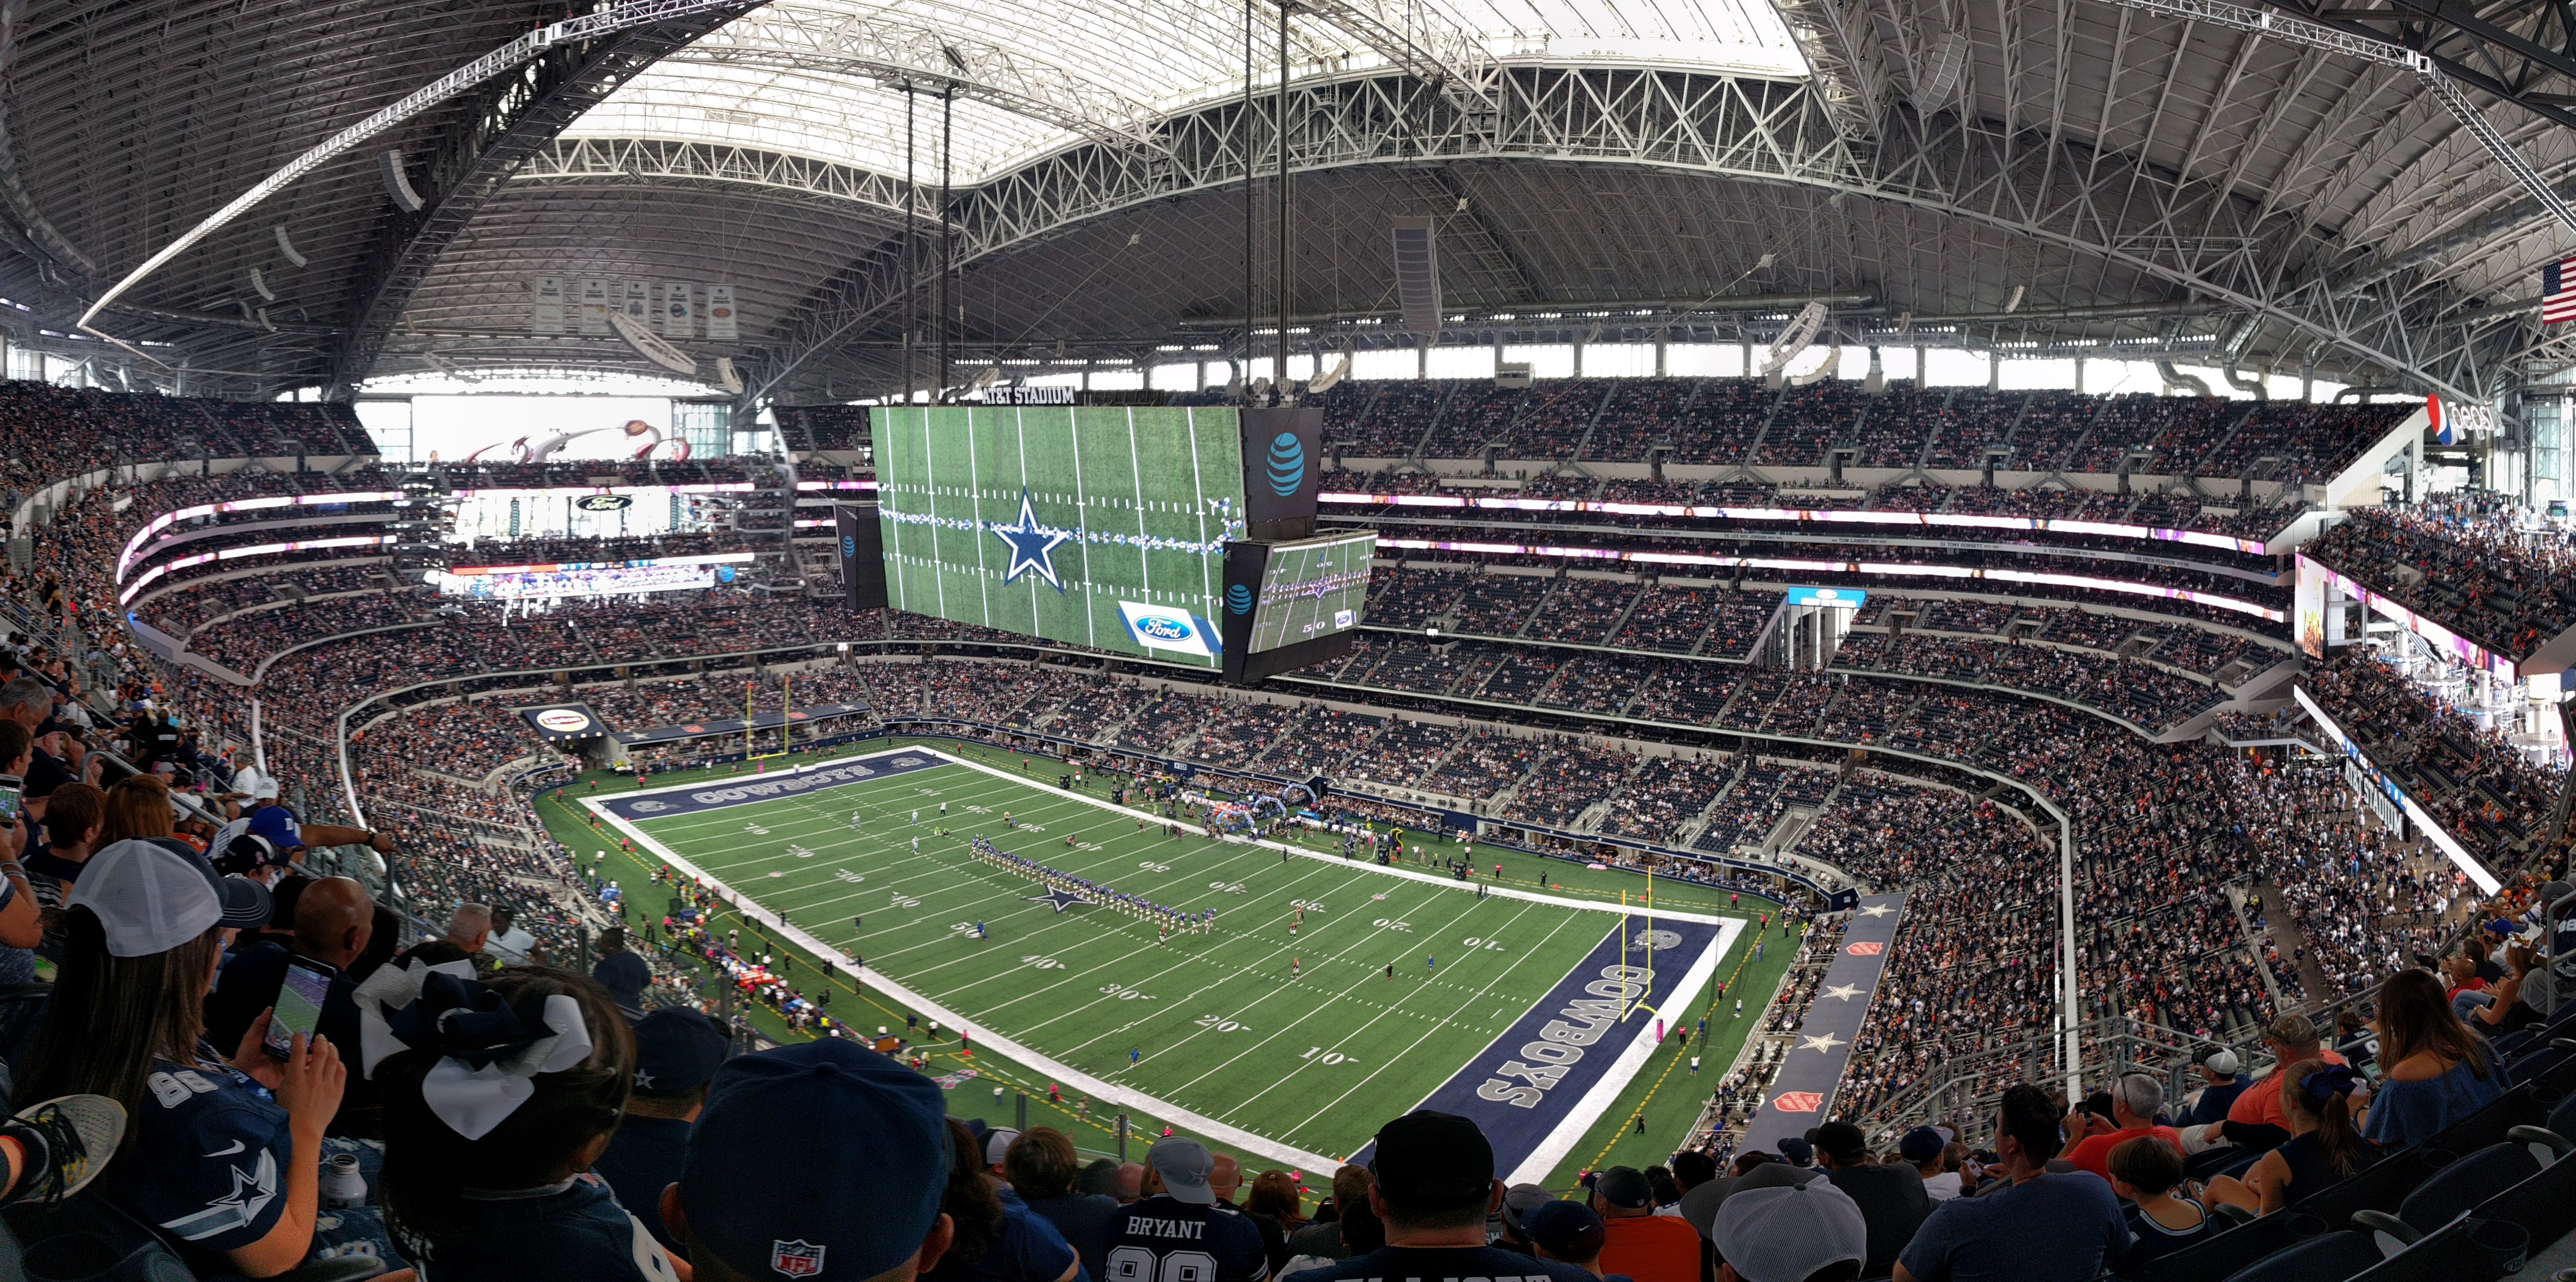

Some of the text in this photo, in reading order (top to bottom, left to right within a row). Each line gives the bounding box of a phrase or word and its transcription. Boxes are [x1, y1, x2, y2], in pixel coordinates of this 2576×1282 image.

[982, 386, 1075, 404] AT&T STADIUM
[2451, 400, 2496, 440] pepsi
[586, 497, 624, 510] Ford
[1145, 617, 1182, 639] Ford
[1302, 621, 1325, 633] 50
[691, 765, 875, 804] COWBOYS
[2344, 757, 2364, 796] AT&T
[2364, 776, 2404, 842] STADIUM
[950, 921, 984, 939] 50
[1099, 983, 1140, 1000] 30
[1193, 1014, 1239, 1032] 20
[1477, 965, 1655, 1108] COWBOYS
[1298, 1046, 1345, 1065] 10
[147, 1070, 219, 1109] 88
[1126, 1216, 1206, 1240] BRYANT
[777, 1255, 817, 1274] NFL
